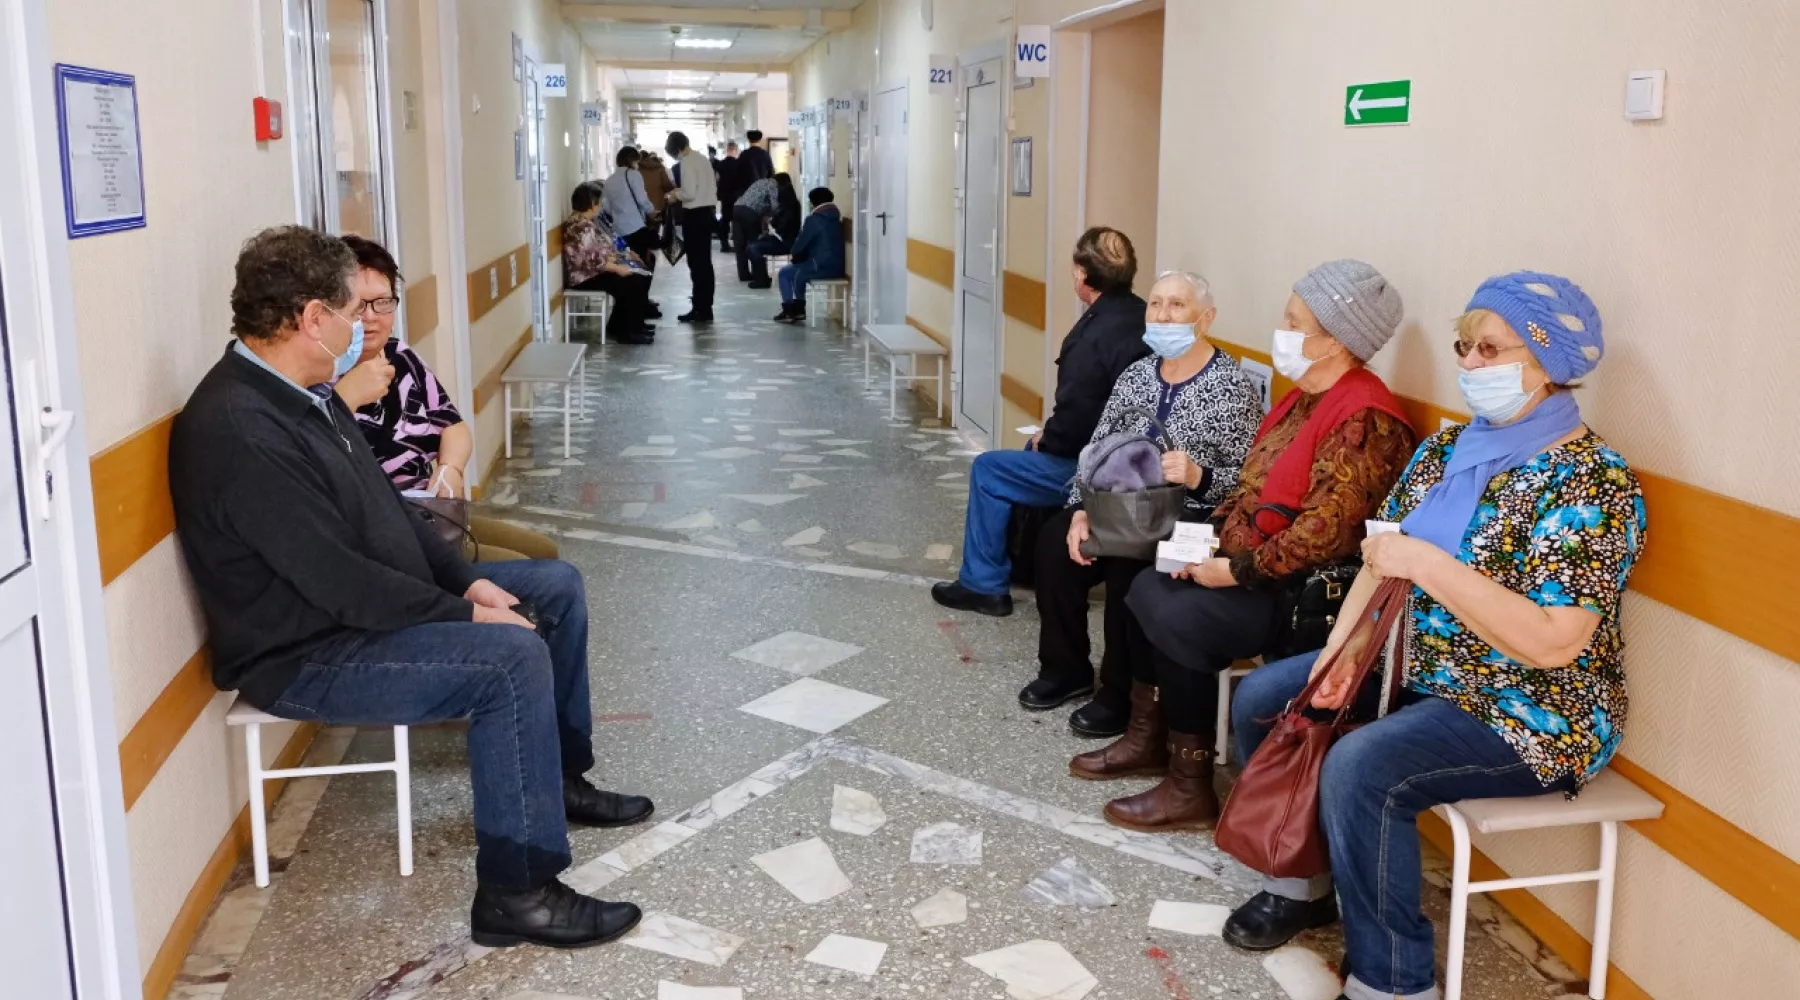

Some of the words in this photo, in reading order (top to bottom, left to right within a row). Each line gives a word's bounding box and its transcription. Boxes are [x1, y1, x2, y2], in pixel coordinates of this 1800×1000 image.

[1018, 43, 1047, 61] WC
[545, 75, 566, 88] 226
[930, 69, 952, 83] 221
[836, 100, 850, 109] 219
[583, 109, 597, 118] 224
